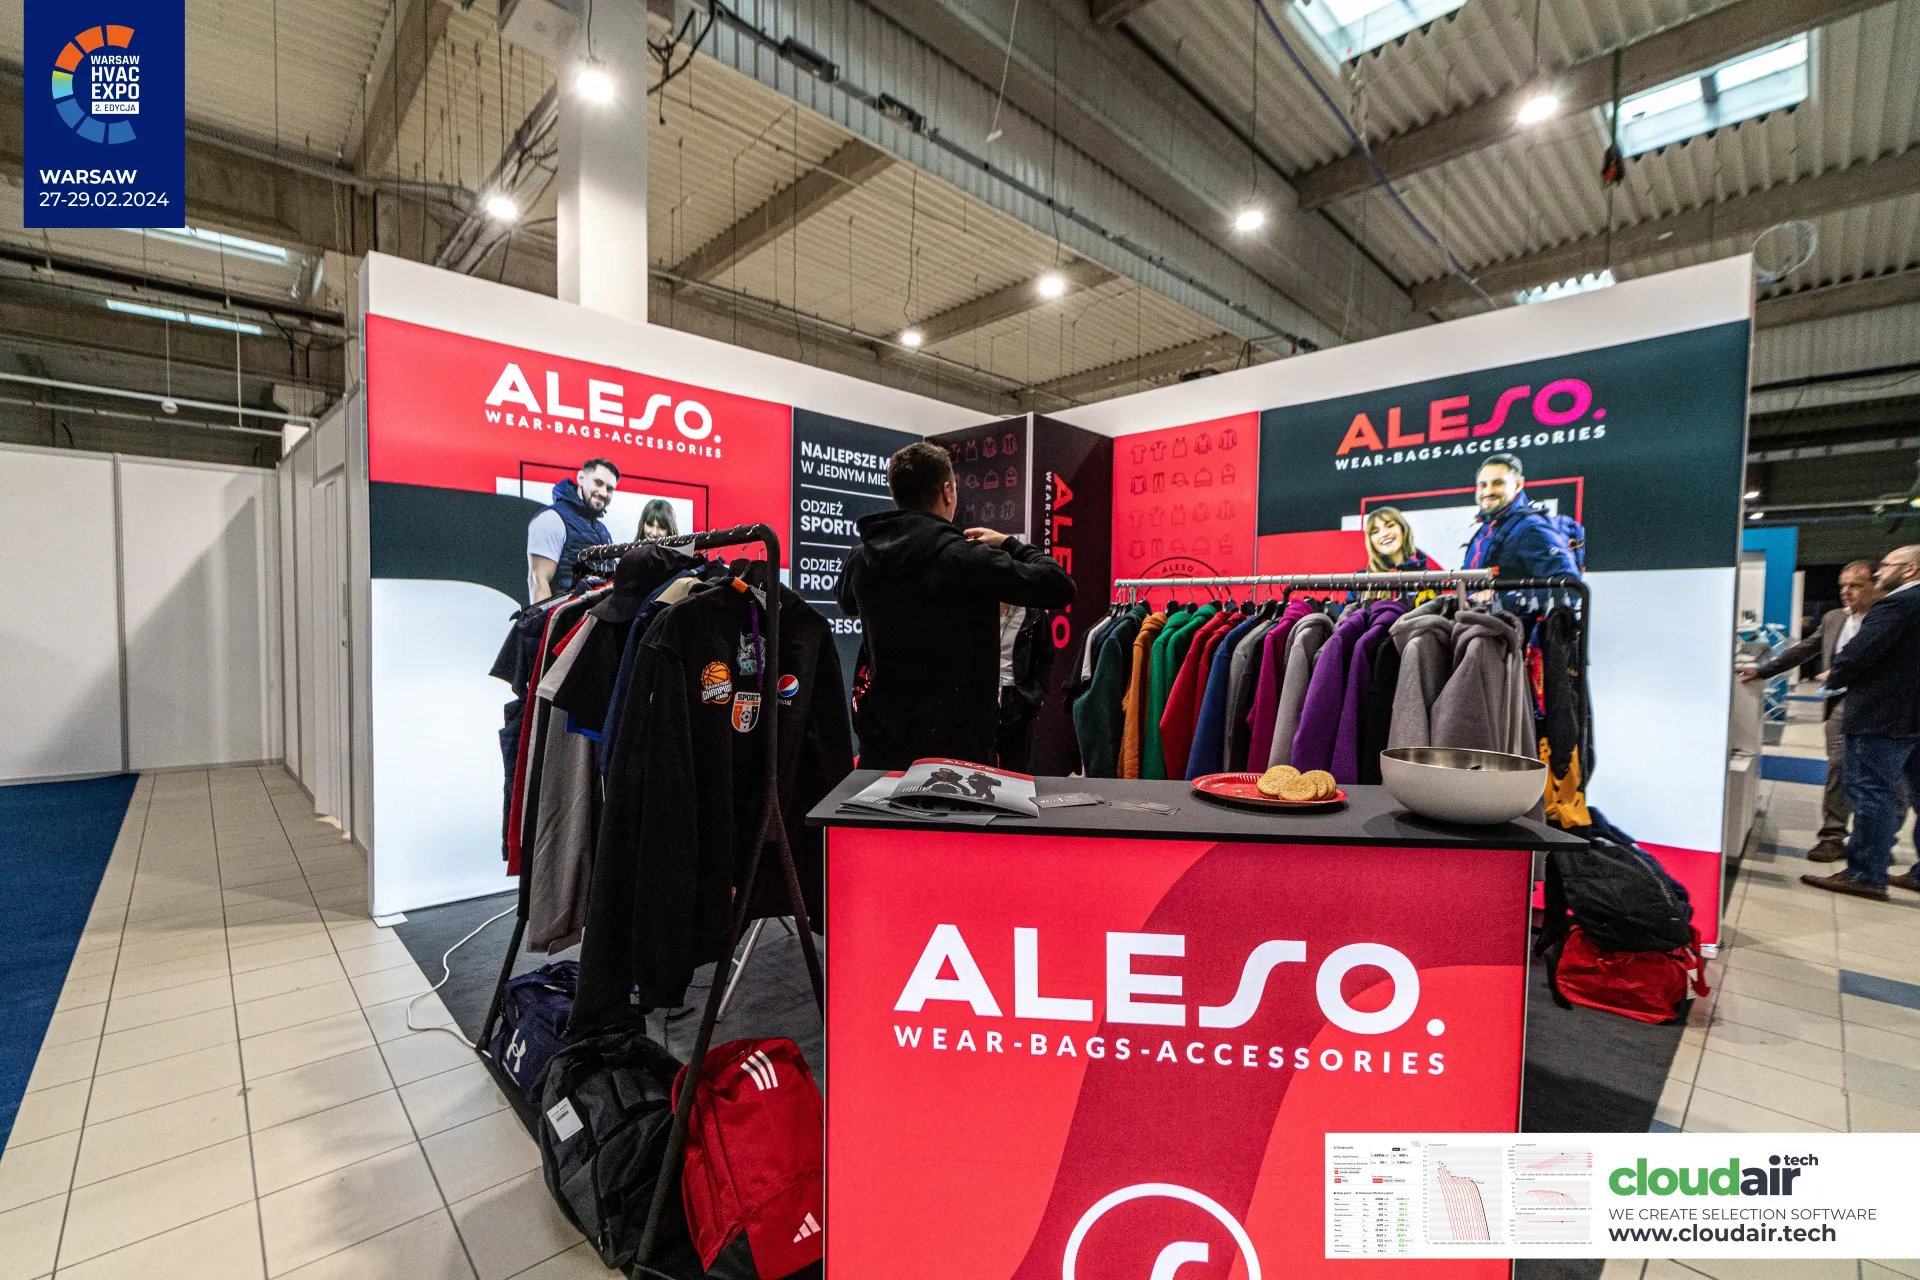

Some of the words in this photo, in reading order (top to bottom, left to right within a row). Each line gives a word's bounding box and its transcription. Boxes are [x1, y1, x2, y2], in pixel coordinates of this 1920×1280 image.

[485, 409, 722, 459] WEAR-BAGS-ACCESSORIES
[801, 441, 877, 469] NAJLEPSZE
[879, 456, 891, 471] M
[1335, 424, 1607, 471] WEAR-BAGS-ACCESSORIES
[801, 460, 815, 474] W
[817, 464, 866, 484] JEDNYM
[868, 471, 890, 486] MIE
[800, 499, 844, 517] ODZIEŻ
[800, 557, 843, 573] ODZIEŻ
[1052, 473, 1074, 649] ALEO
[1162, 564, 1194, 574] ALESO
[800, 573, 839, 591] PRO
[737, 693, 760, 702] SPORT
[893, 1025, 1446, 1075] WEAR-BAGS-ACCESSORIES
